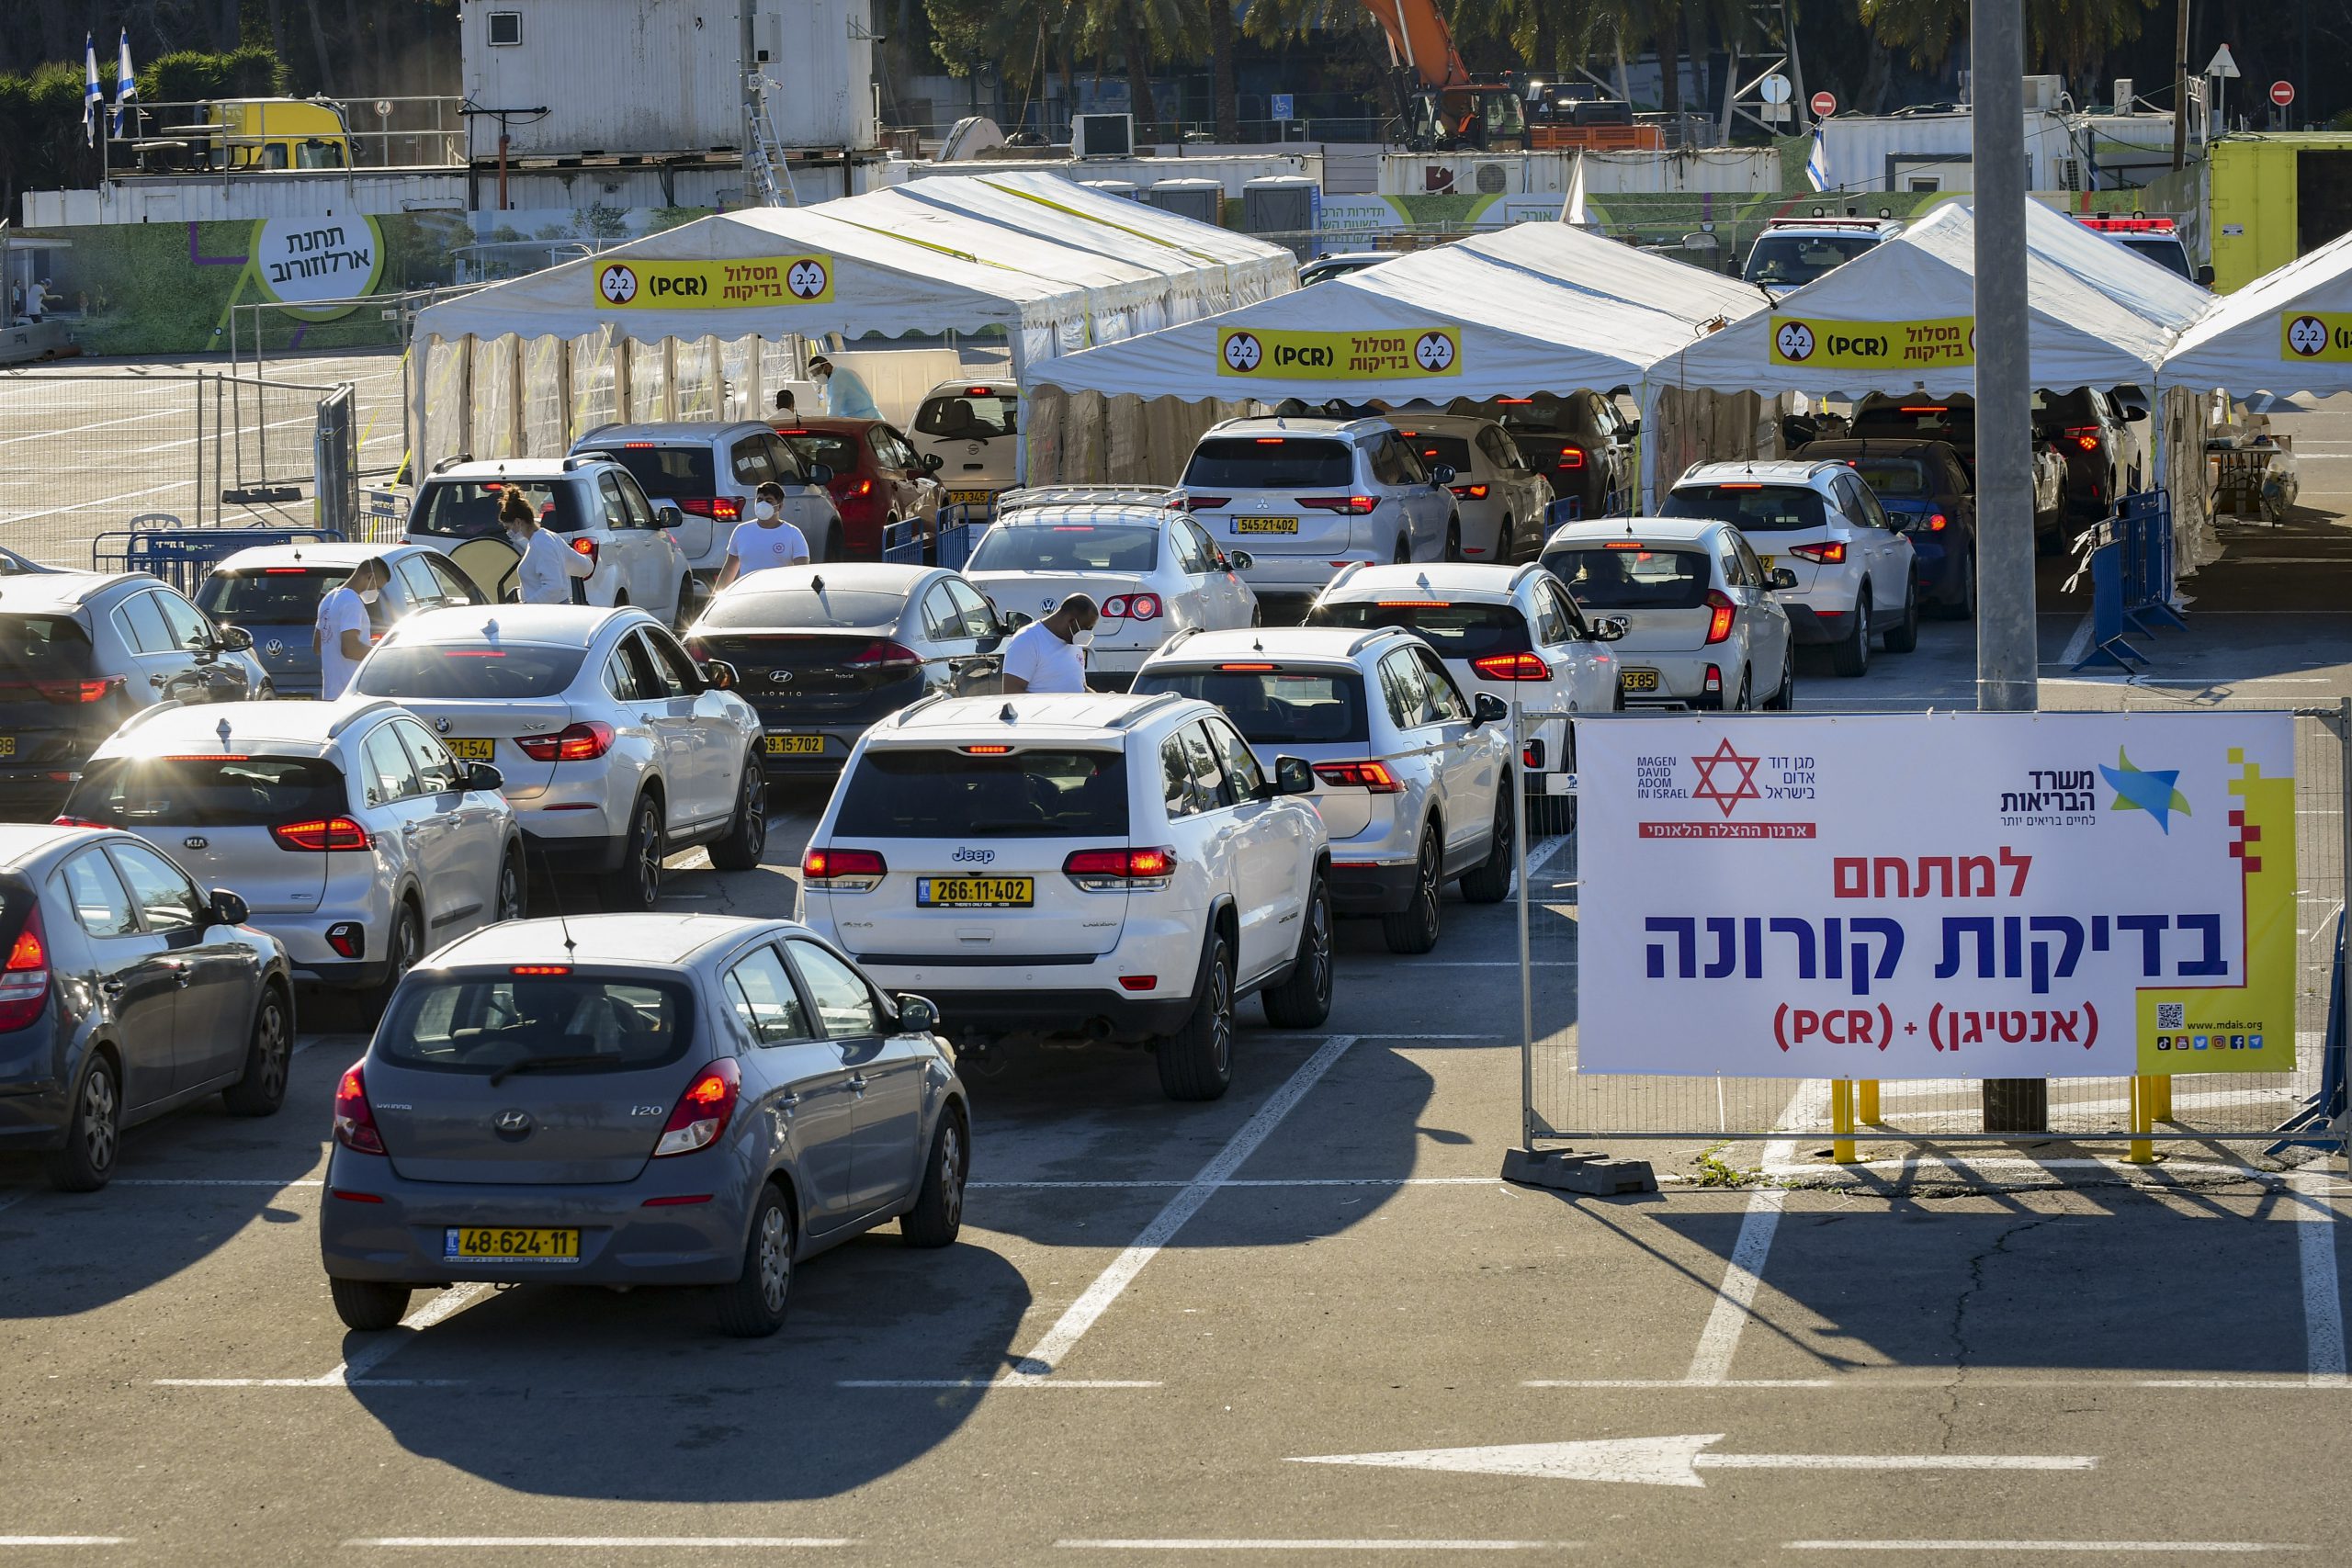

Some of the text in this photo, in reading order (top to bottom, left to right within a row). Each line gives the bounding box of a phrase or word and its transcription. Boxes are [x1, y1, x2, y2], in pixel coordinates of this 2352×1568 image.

[1348, 207, 1385, 218] תדירות
[286, 227, 345, 254] תחנת
[269, 248, 370, 283] ארלוזורוב
[724, 265, 778, 281] מסלול
[609, 278, 630, 289] 2.2
[650, 276, 707, 297] (PCR)
[796, 274, 818, 285] 2.2
[723, 283, 783, 301] בדיקות
[1785, 335, 1805, 347] 2.2
[1905, 326, 1960, 343] מסלול
[2298, 331, 2318, 341] 2.2
[1233, 345, 1253, 357] 2.2
[1351, 337, 1406, 354] מסלול
[1423, 345, 1446, 357] 2.2
[1826, 334, 1888, 356] (PCR)
[1904, 344, 1964, 362] בדיקות
[1274, 344, 1334, 367] (PCR)
[1349, 355, 1409, 373] בדיקות
[1637, 756, 1677, 767] MAGEN
[1769, 757, 1815, 771] מגן דוד
[1637, 767, 1671, 777] DAVID
[1783, 772, 1815, 784] אדום
[1637, 777, 1672, 788] ADOM
[2029, 771, 2095, 790] משרד
[1637, 788, 1689, 798] IN ISRAEL
[1765, 784, 1815, 799] בישראל
[2000, 792, 2095, 812] הבריאות
[2000, 815, 2096, 826] לחיים בריאים יותר
[1648, 823, 1807, 839] ארגון ההצלה הלאומי
[187, 839, 204, 847] KIA
[952, 847, 995, 863] Jeep
[1833, 846, 2033, 898] למתחם
[1645, 914, 2229, 996] בדיקות קורונה
[1773, 1001, 1894, 1053] (PCR)
[1928, 1001, 2098, 1052] (אנטיגן)
[2187, 1021, 2263, 1031] www.mdais.org
[631, 1105, 662, 1116] i20
